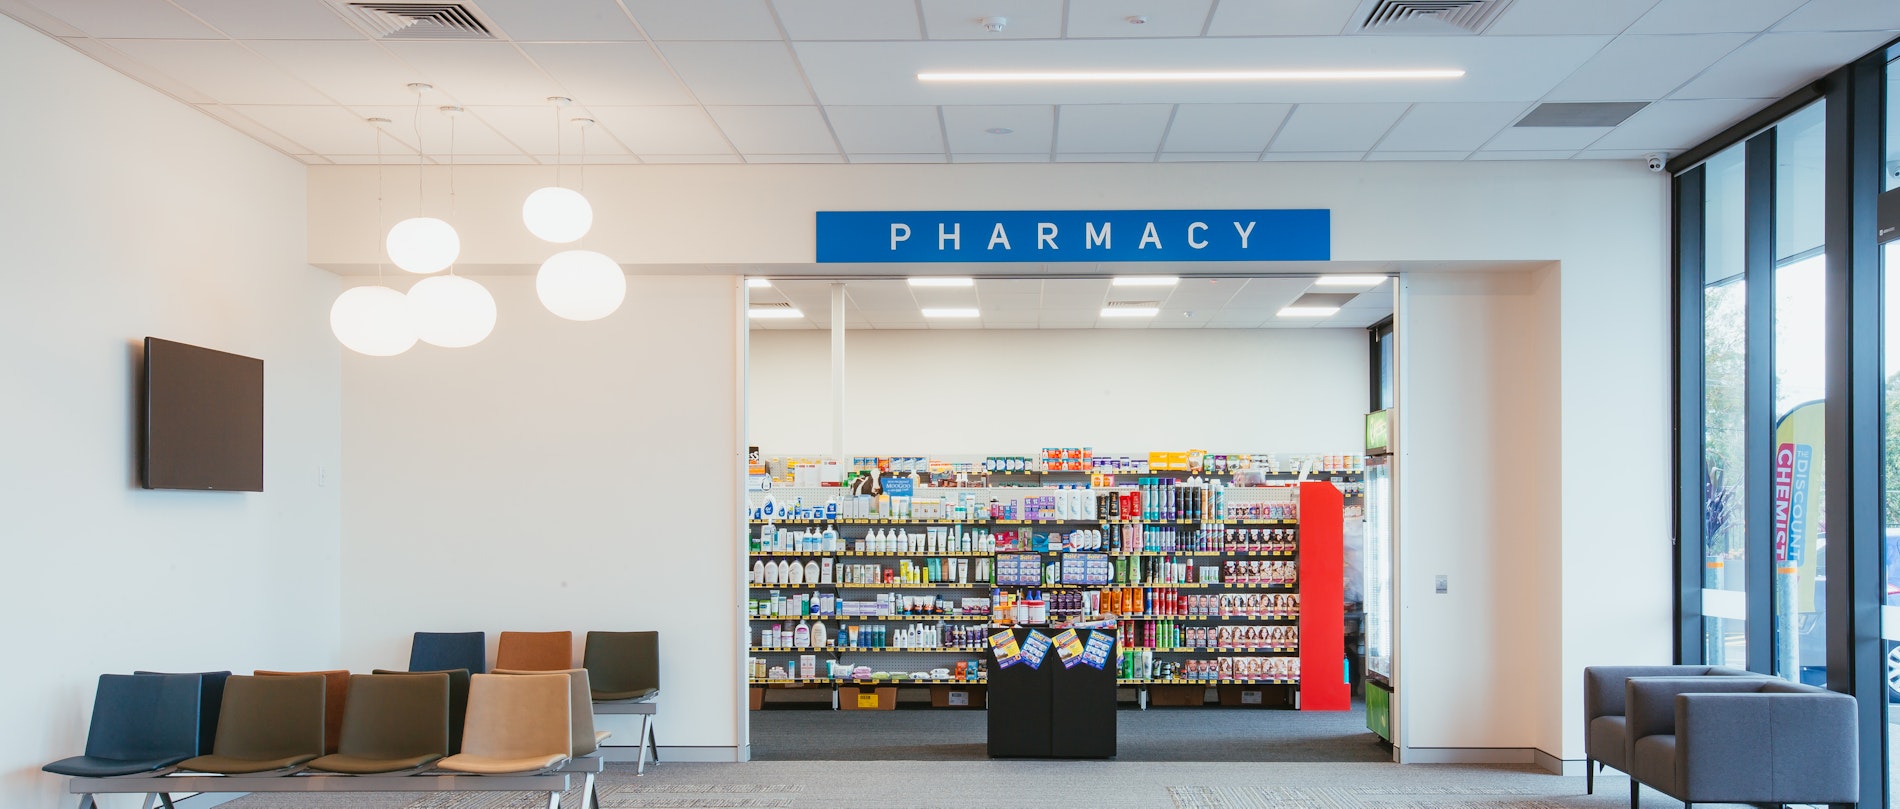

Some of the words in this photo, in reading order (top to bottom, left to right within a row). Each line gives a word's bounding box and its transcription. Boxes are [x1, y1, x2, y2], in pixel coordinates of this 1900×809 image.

[890, 221, 1257, 251] PHARMACY
[1776, 449, 1792, 559] CHEMIST
[1789, 460, 1808, 560] DISCOUNT
